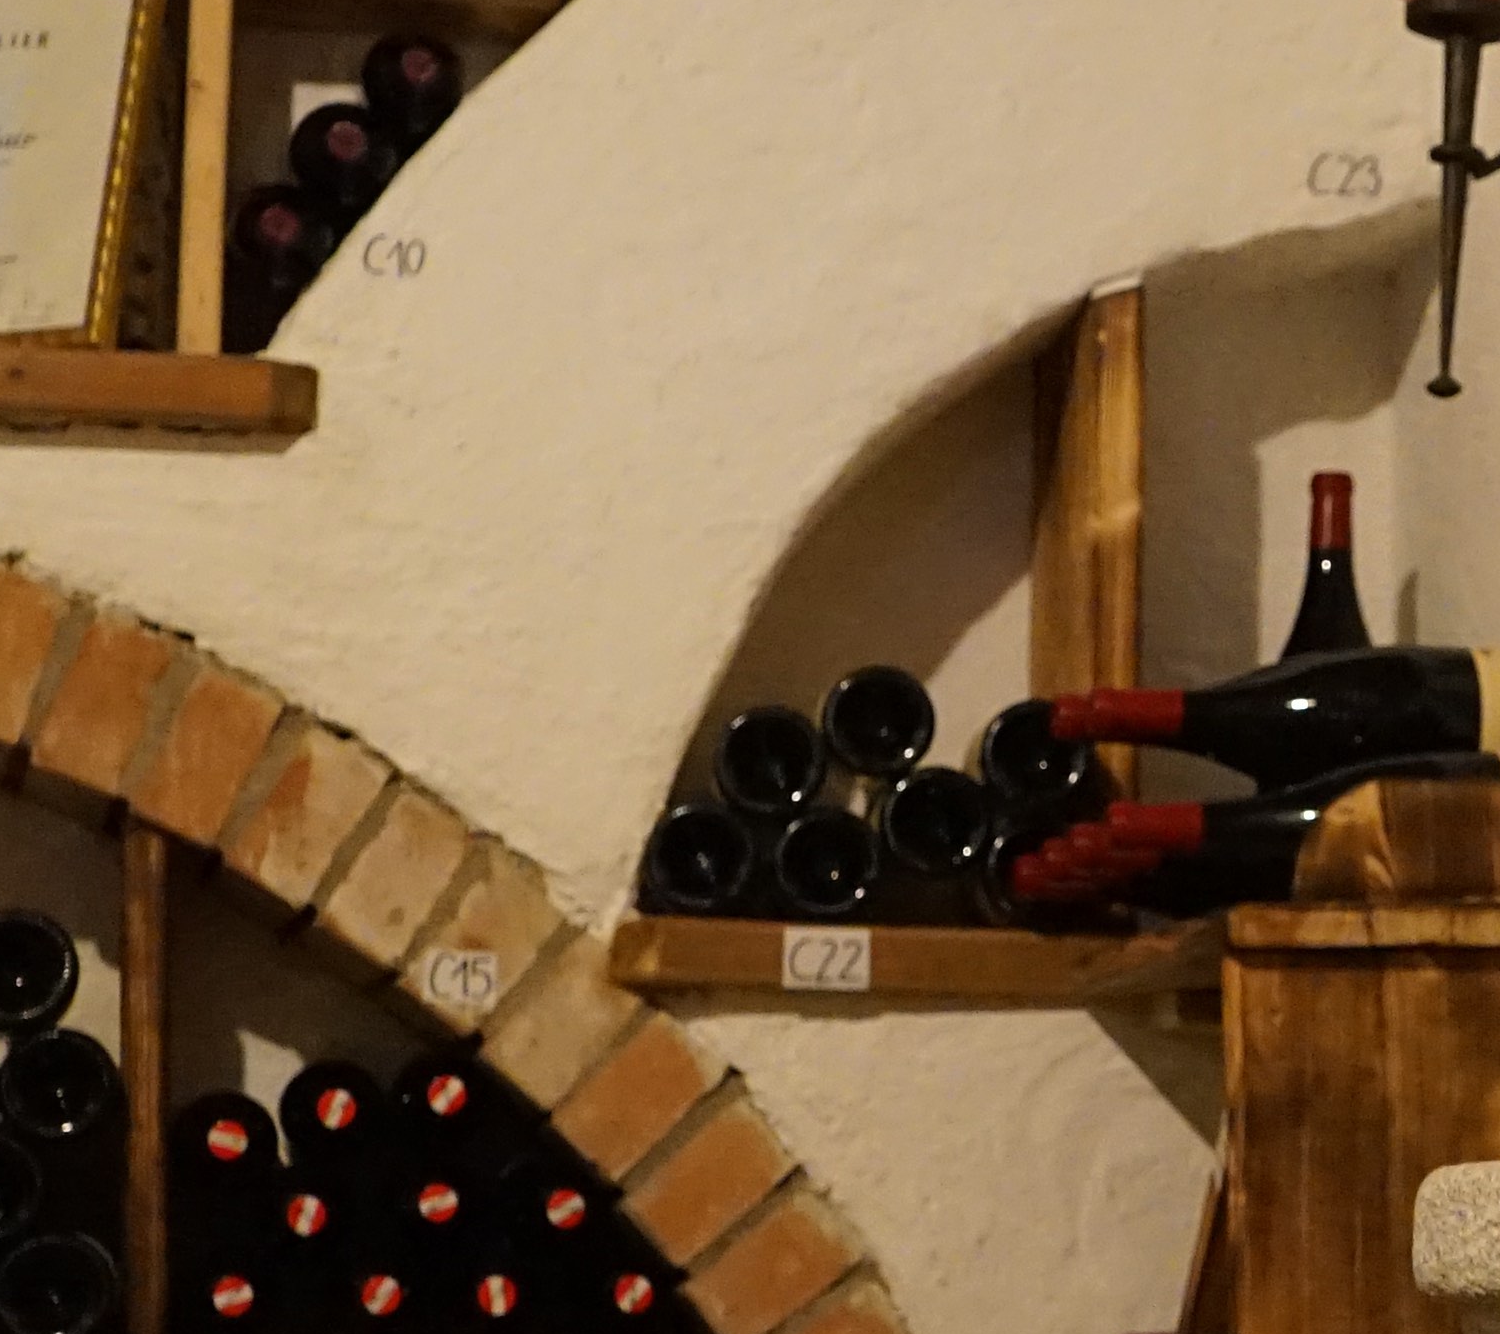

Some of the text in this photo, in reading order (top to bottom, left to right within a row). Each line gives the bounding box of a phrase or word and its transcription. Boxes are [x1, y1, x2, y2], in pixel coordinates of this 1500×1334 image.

[1306, 151, 1382, 197] C23
[362, 232, 426, 279] C10
[428, 953, 493, 1001] C15
[788, 936, 864, 981] C22
